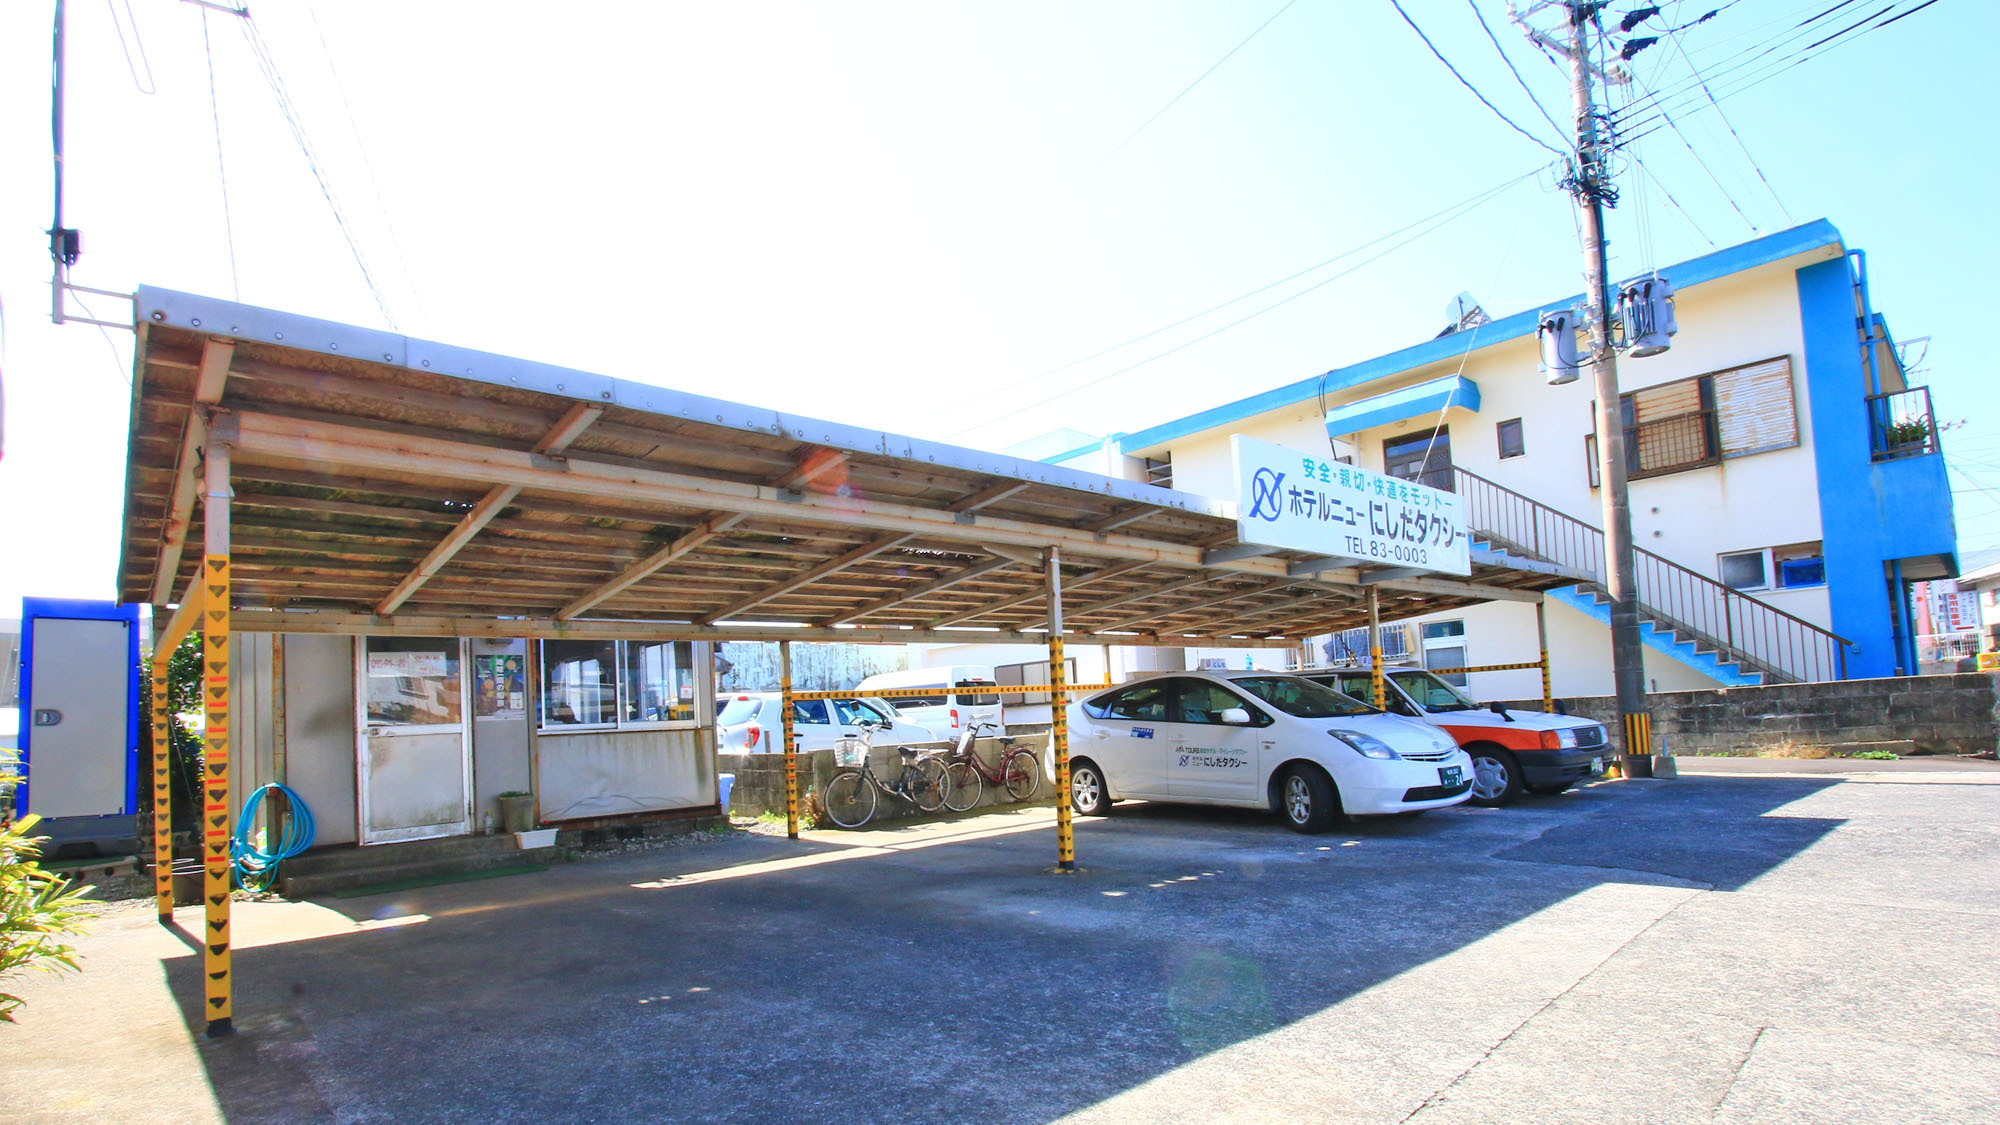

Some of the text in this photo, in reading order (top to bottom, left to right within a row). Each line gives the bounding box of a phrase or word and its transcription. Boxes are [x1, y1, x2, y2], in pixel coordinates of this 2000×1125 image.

[1302, 457, 1453, 511] 安全・親切・快適をモットー
[1345, 535, 1427, 564] TEL 83-0003
[1203, 756, 1248, 768] にしだタクシー
